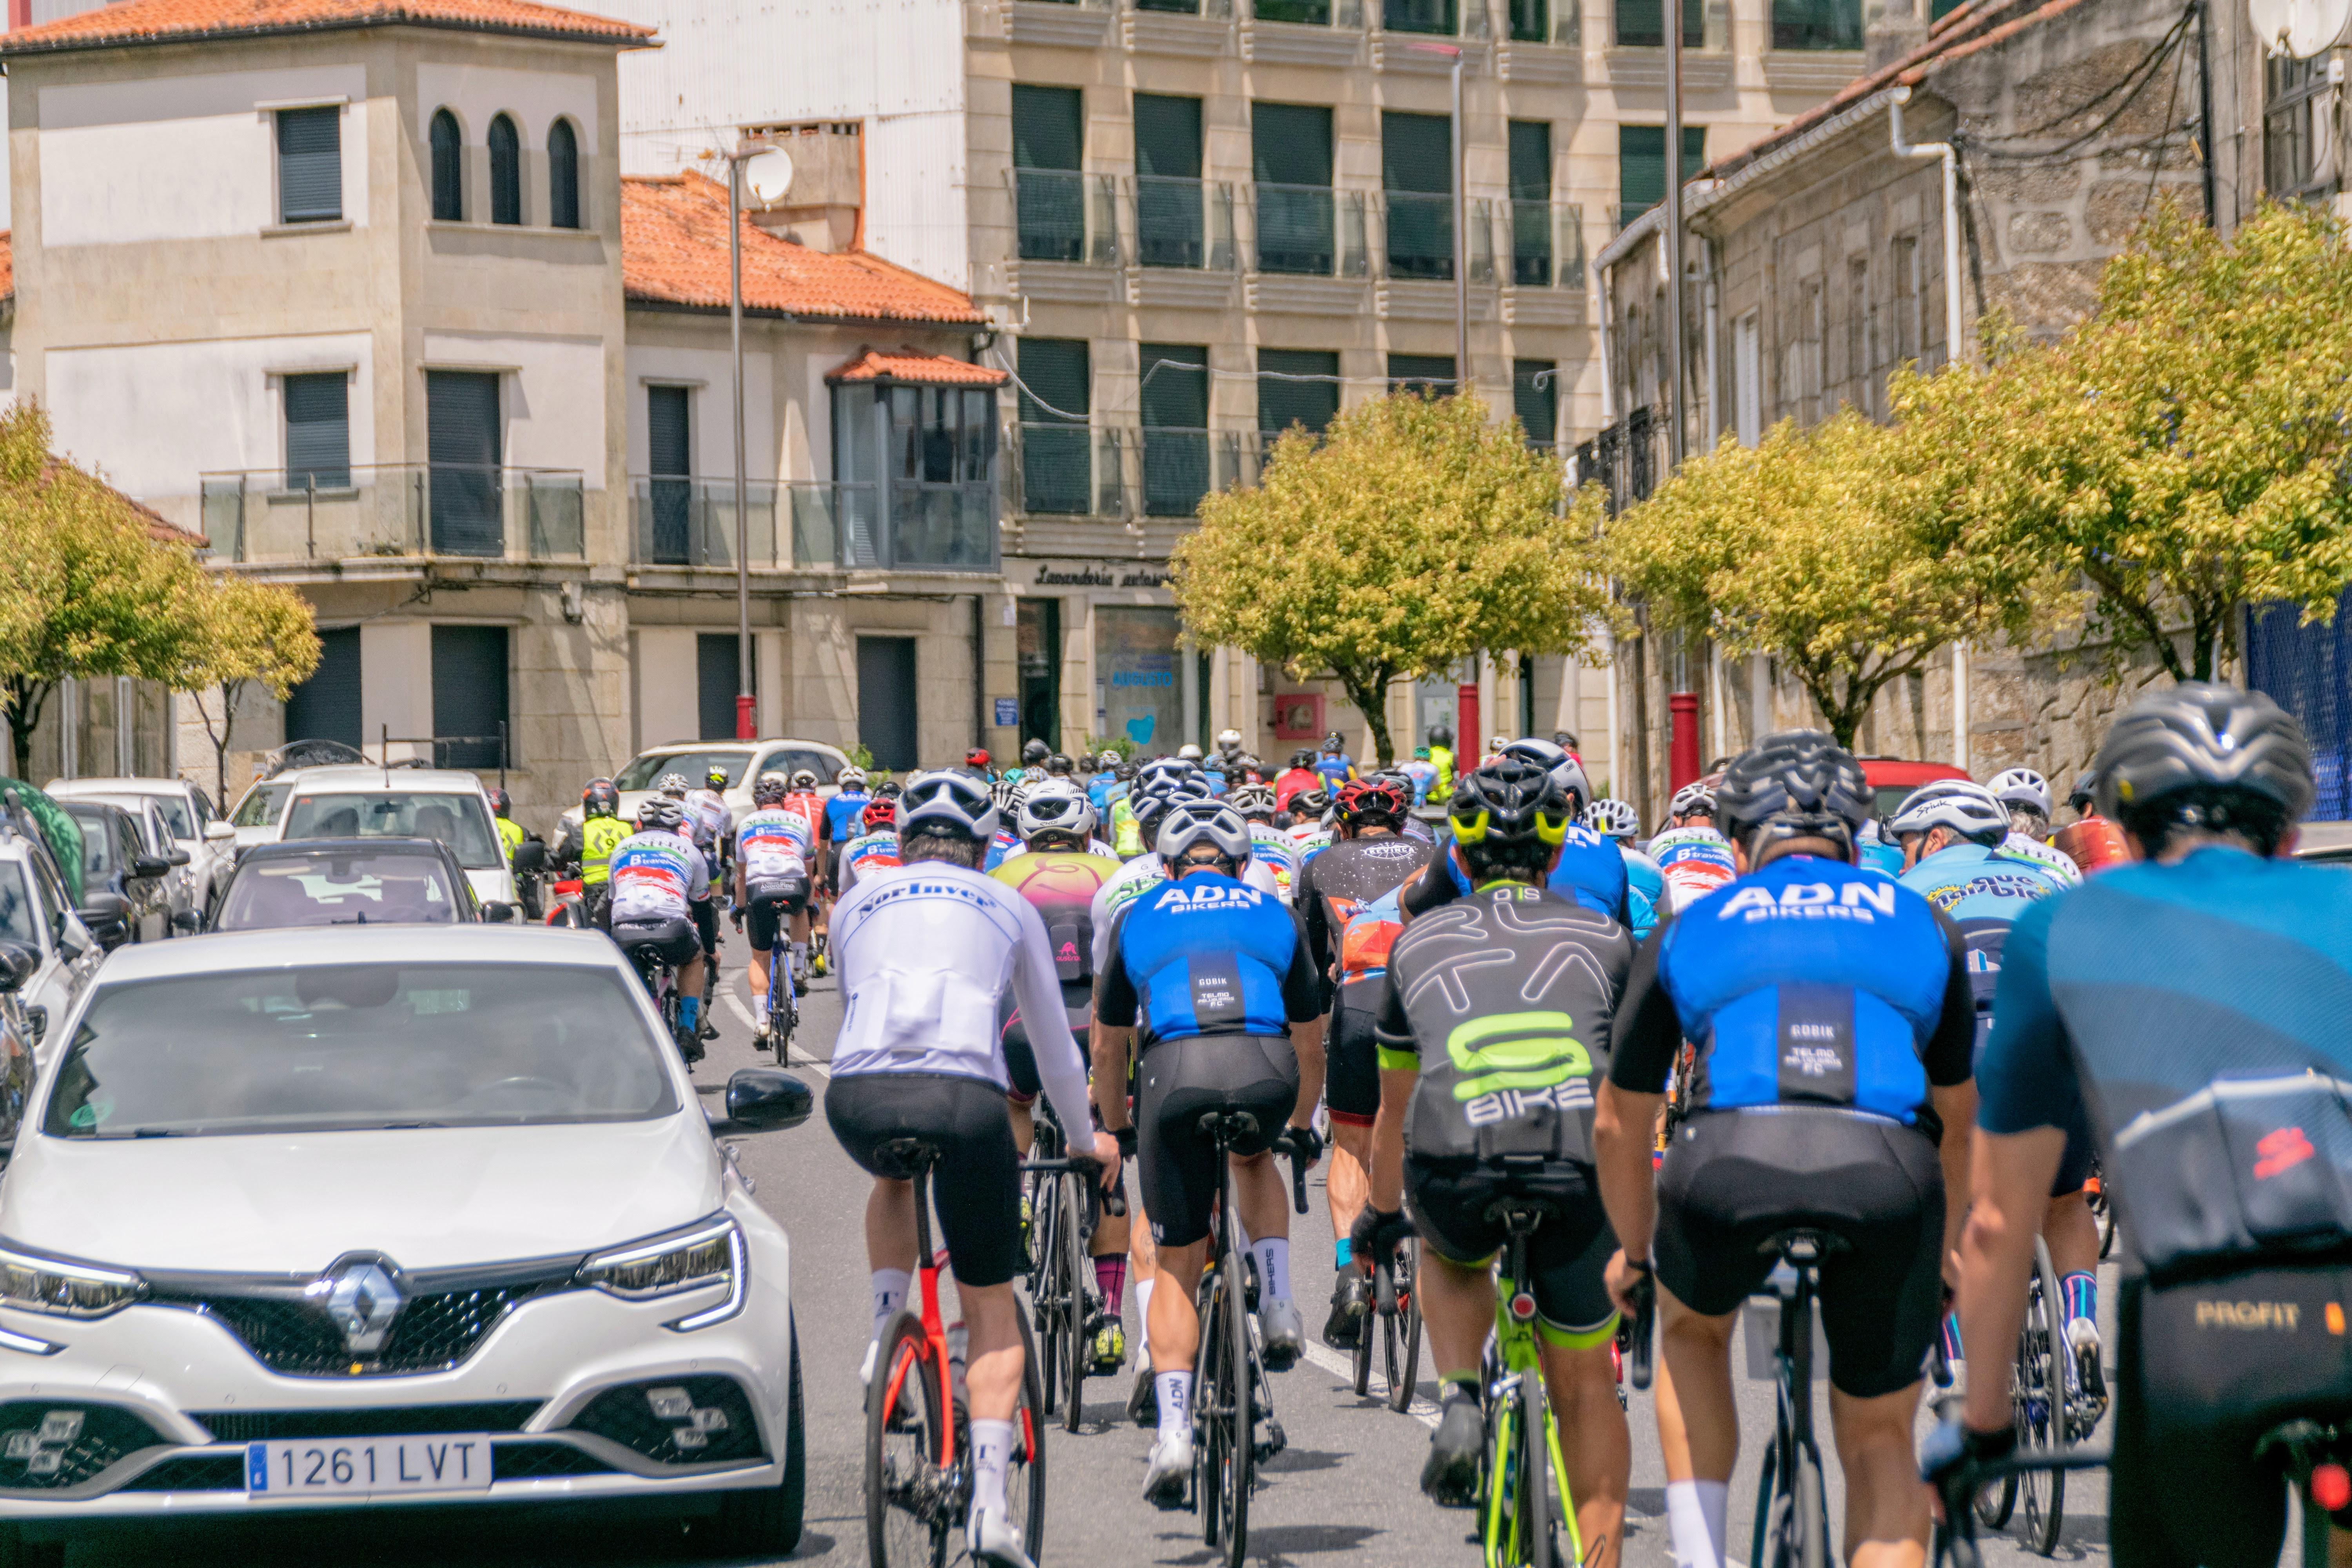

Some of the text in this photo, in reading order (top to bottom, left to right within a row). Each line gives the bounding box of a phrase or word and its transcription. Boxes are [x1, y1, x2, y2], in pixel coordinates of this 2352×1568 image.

[1112, 671, 1172, 687] AUGUSTO
[1916, 799, 1952, 818] Spiuk
[1362, 847, 1415, 855] TREVINCA
[1154, 885, 1261, 910] ADN
[1171, 900, 1250, 913] BIKERS
[1718, 882, 1895, 920] ADN
[1745, 904, 1875, 924] BIKERS
[1465, 1077, 1594, 1125] BIKE
[1266, 1248, 1276, 1296] BIKERS
[2196, 1301, 2300, 1326] PROFIT
[1169, 1377, 1184, 1411] ADN
[282, 1441, 477, 1487] 1261 LVT
